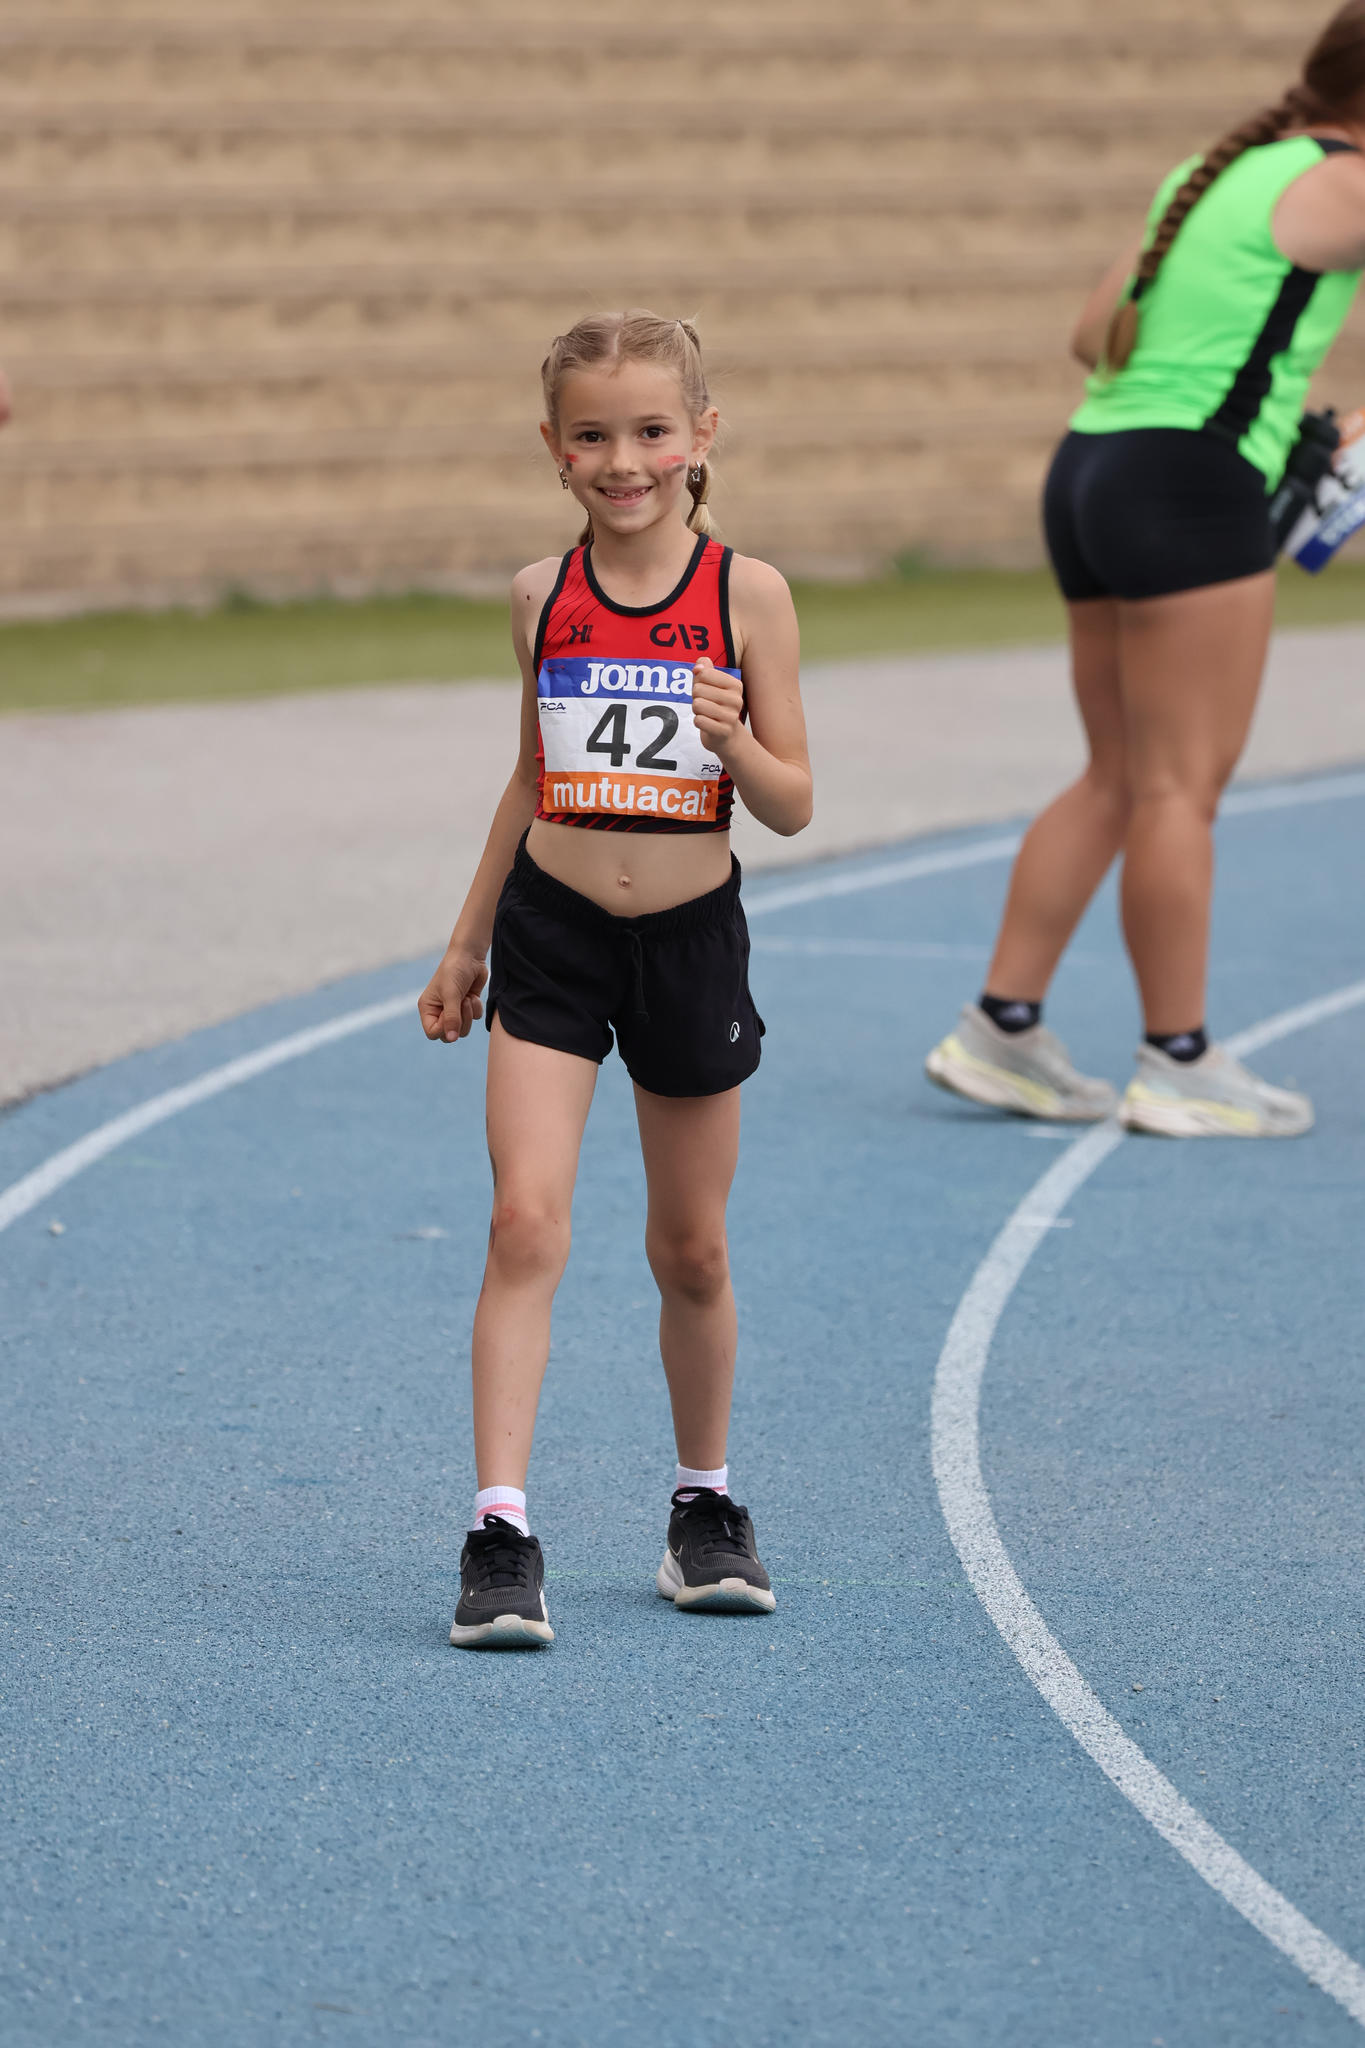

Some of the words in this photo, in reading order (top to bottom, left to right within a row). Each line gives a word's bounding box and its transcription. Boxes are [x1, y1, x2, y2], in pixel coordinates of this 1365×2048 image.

[540, 702, 566, 711] FCA
[586, 703, 679, 771] 42
[701, 763, 720, 773] FCA
[553, 777, 708, 816] mutuacat
